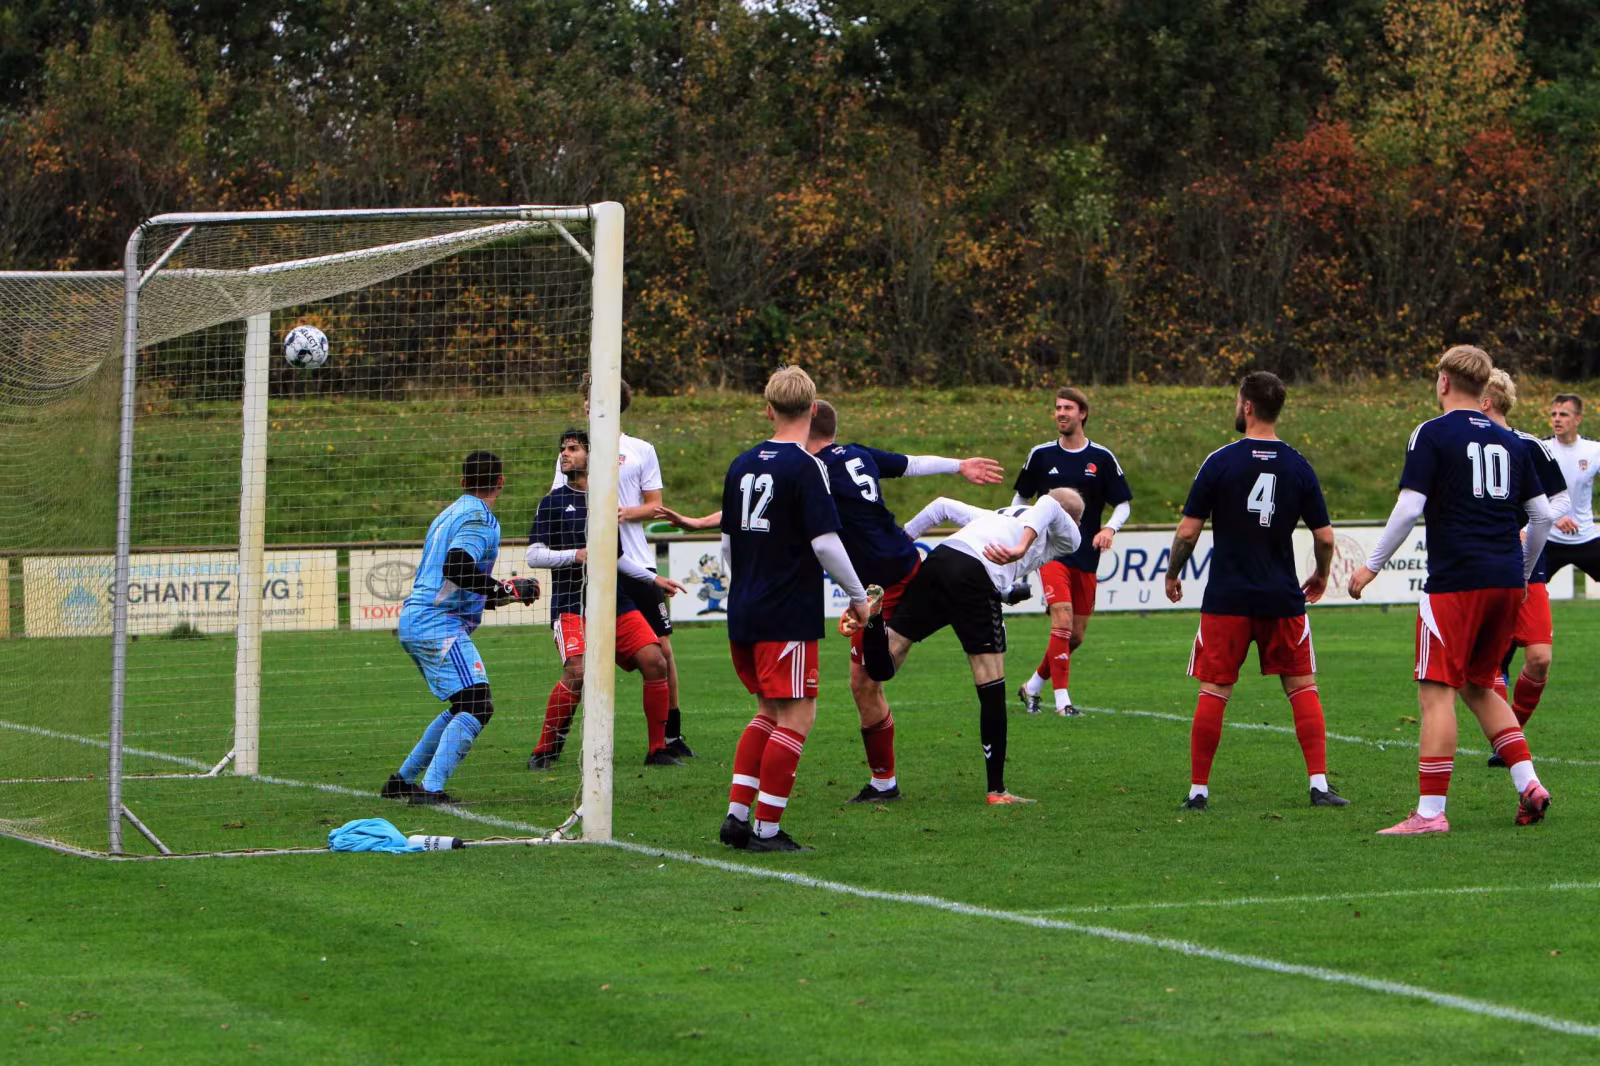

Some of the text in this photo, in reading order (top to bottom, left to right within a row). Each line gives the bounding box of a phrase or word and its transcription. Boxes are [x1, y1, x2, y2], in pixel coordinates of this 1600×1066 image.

[299, 328, 318, 348] SELECT
[845, 457, 879, 503] 5
[1467, 442, 1511, 500] 10
[740, 473, 774, 532] 12
[1247, 472, 1277, 528] 4
